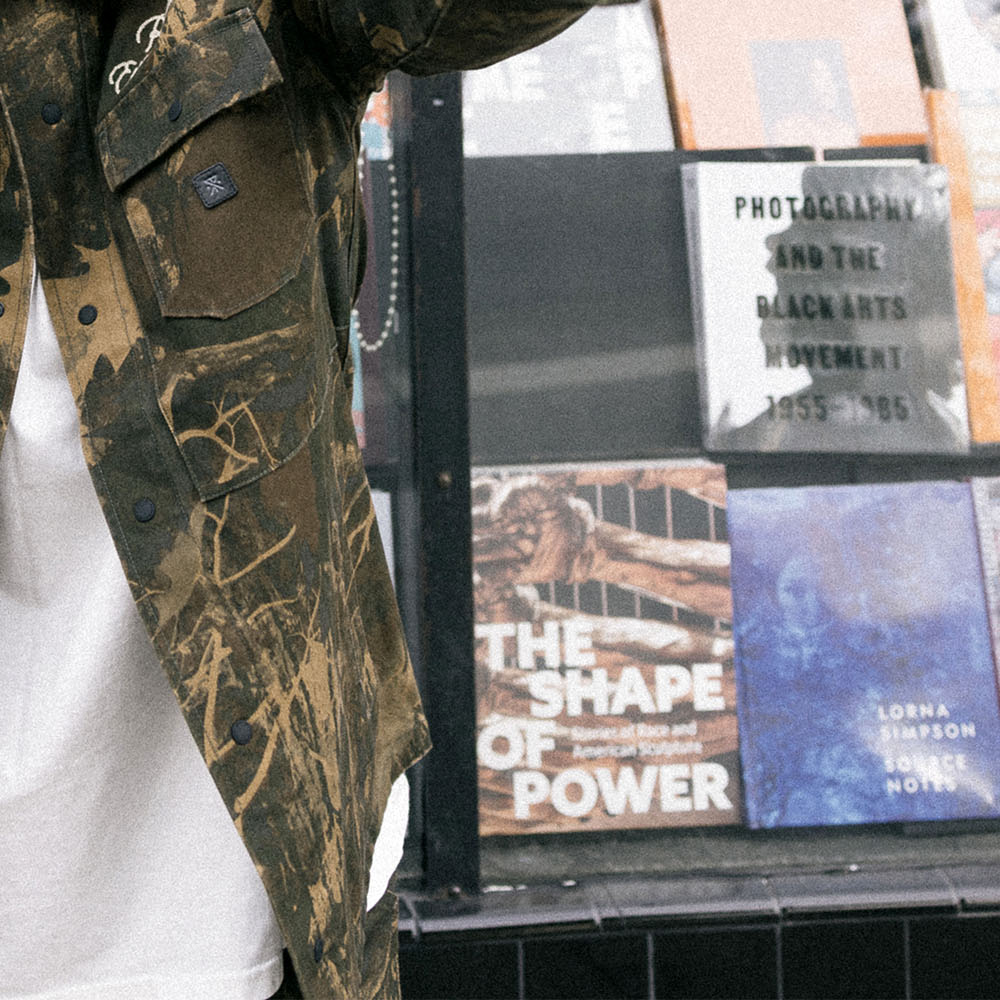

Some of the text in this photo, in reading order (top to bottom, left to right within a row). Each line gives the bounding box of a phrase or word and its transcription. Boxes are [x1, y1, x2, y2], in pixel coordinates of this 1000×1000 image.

[735, 196, 916, 221] PHOTOGRAPHY
[776, 244, 881, 270] AND THE
[757, 294, 907, 320] BLACK ARTS
[765, 344, 902, 369] MOVEMENT
[474, 619, 597, 672] THE
[527, 662, 726, 718] SHAPE
[878, 704, 950, 720] LORNA
[880, 721, 976, 740] SIMPSON
[476, 719, 556, 770] OF
[512, 762, 734, 820] POWER
